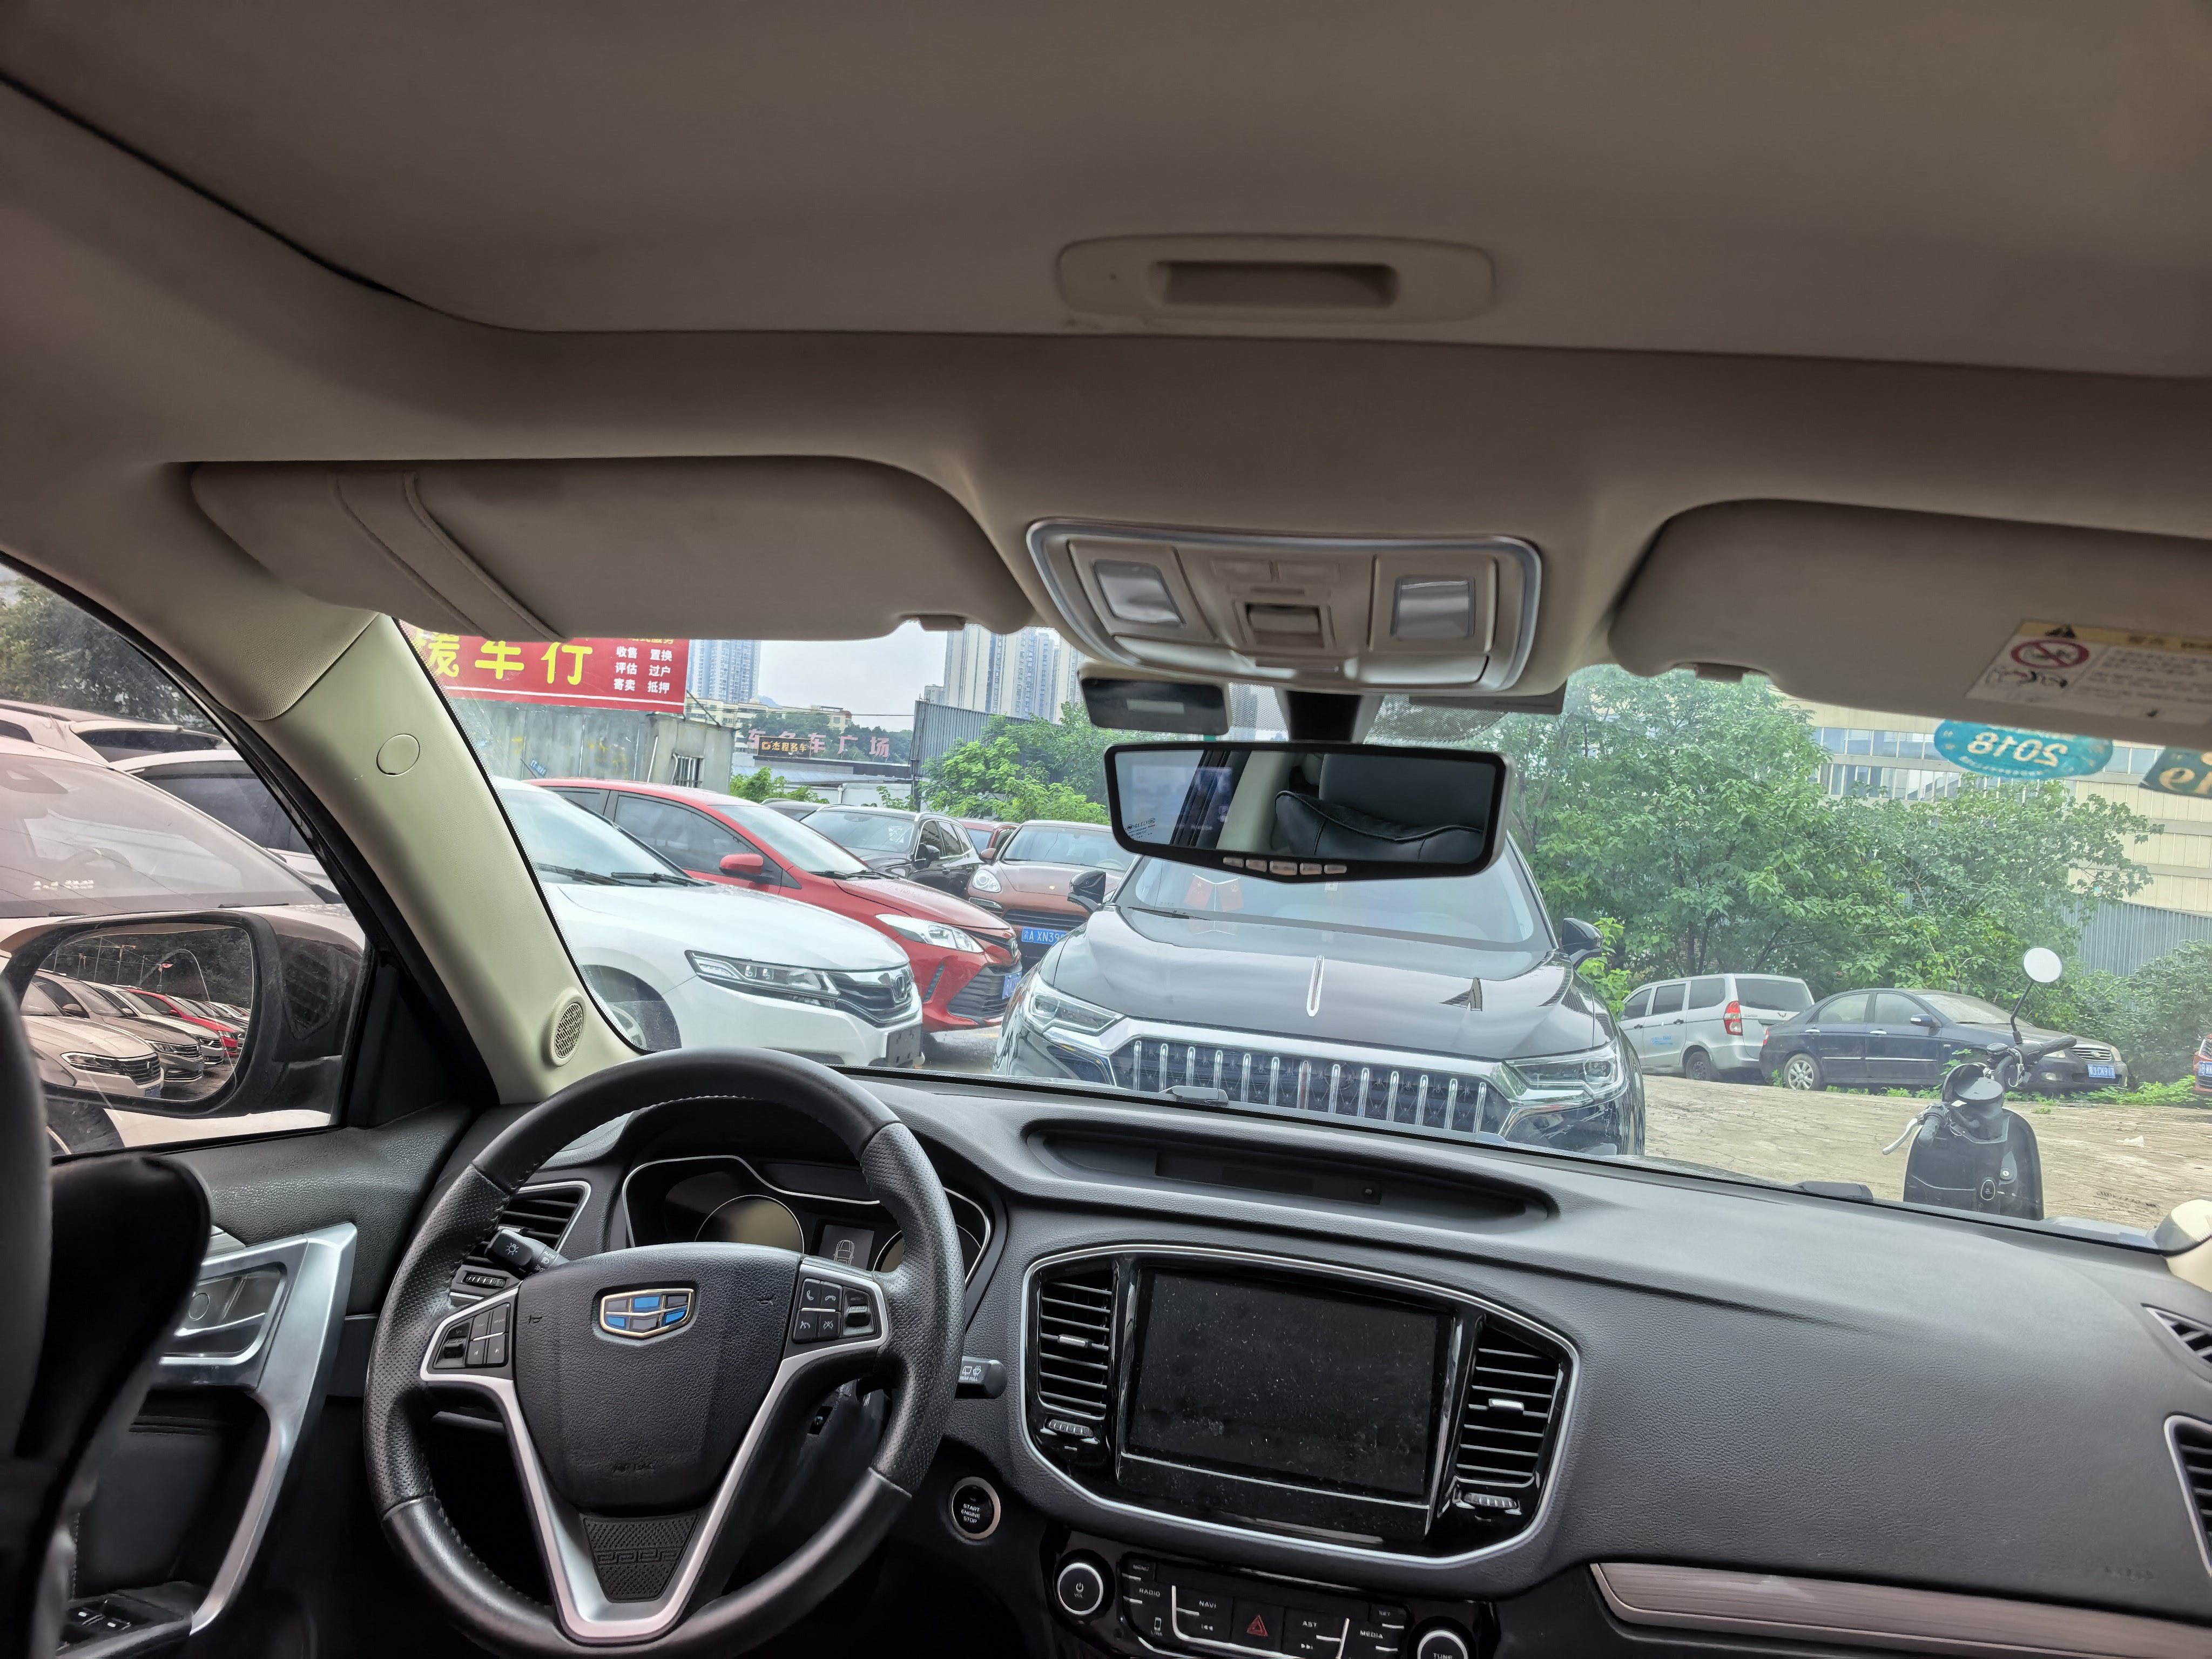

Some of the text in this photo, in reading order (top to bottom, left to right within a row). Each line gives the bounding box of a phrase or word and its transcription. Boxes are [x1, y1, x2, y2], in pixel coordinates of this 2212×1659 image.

[616, 645, 672, 662] 收售 置换
[615, 662, 671, 677] 评估 过户
[613, 678, 670, 694] 寄卖 抵押
[963, 1503, 981, 1513] START
[961, 1509, 980, 1518] ENGINE
[963, 1515, 977, 1523] STOP
[1139, 1588, 1161, 1597] RADIO
[1199, 1600, 1216, 1609] NAVI
[1360, 1630, 1383, 1639] MEDIA
